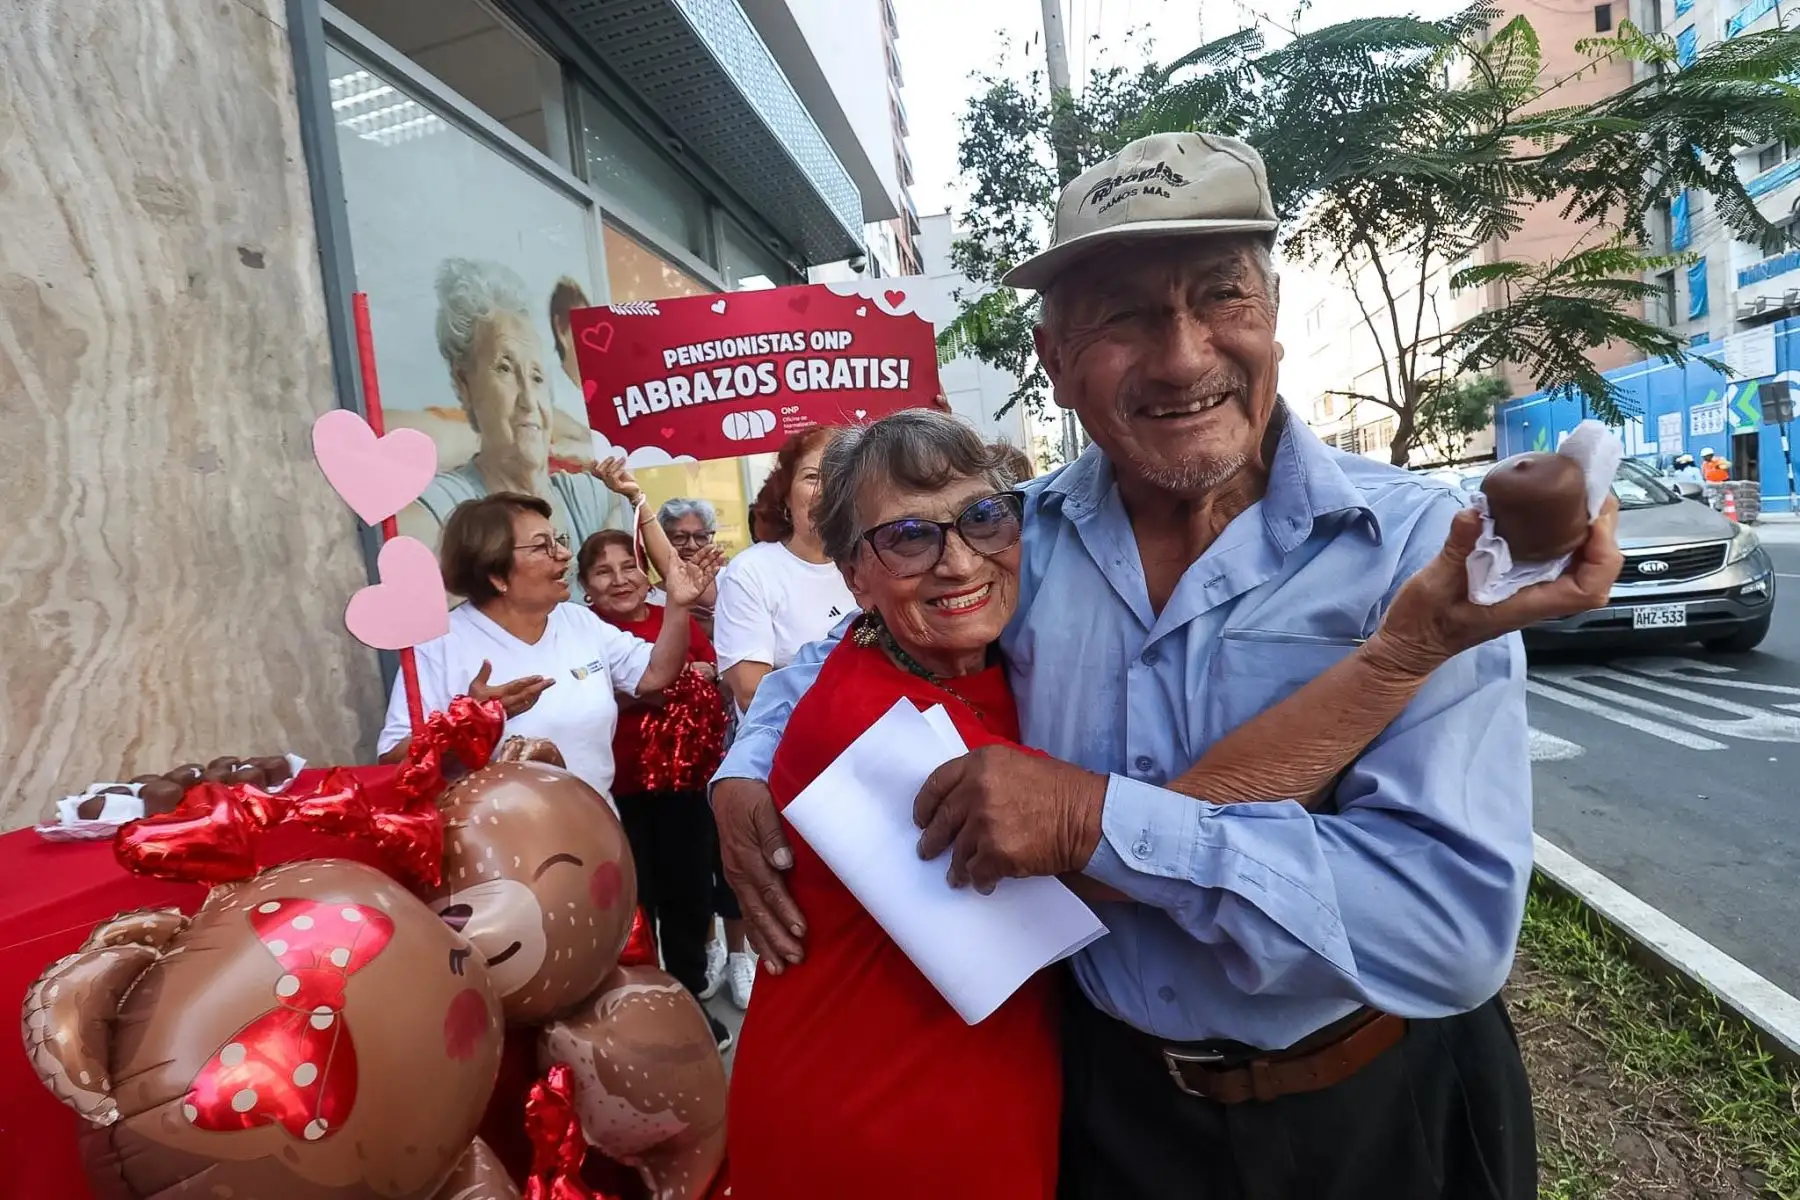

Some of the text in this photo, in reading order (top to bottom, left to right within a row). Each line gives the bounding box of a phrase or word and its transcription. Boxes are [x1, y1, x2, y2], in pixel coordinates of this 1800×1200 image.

[1098, 188, 1138, 214] DAMOS
[663, 330, 852, 368] PENSIONISTAS ONP
[612, 358, 910, 426] ¡ABRAZOS GRATIS!
[781, 405, 800, 415] ONP
[1642, 562, 1666, 572] KIA
[1636, 610, 1684, 624] AHZ-533
